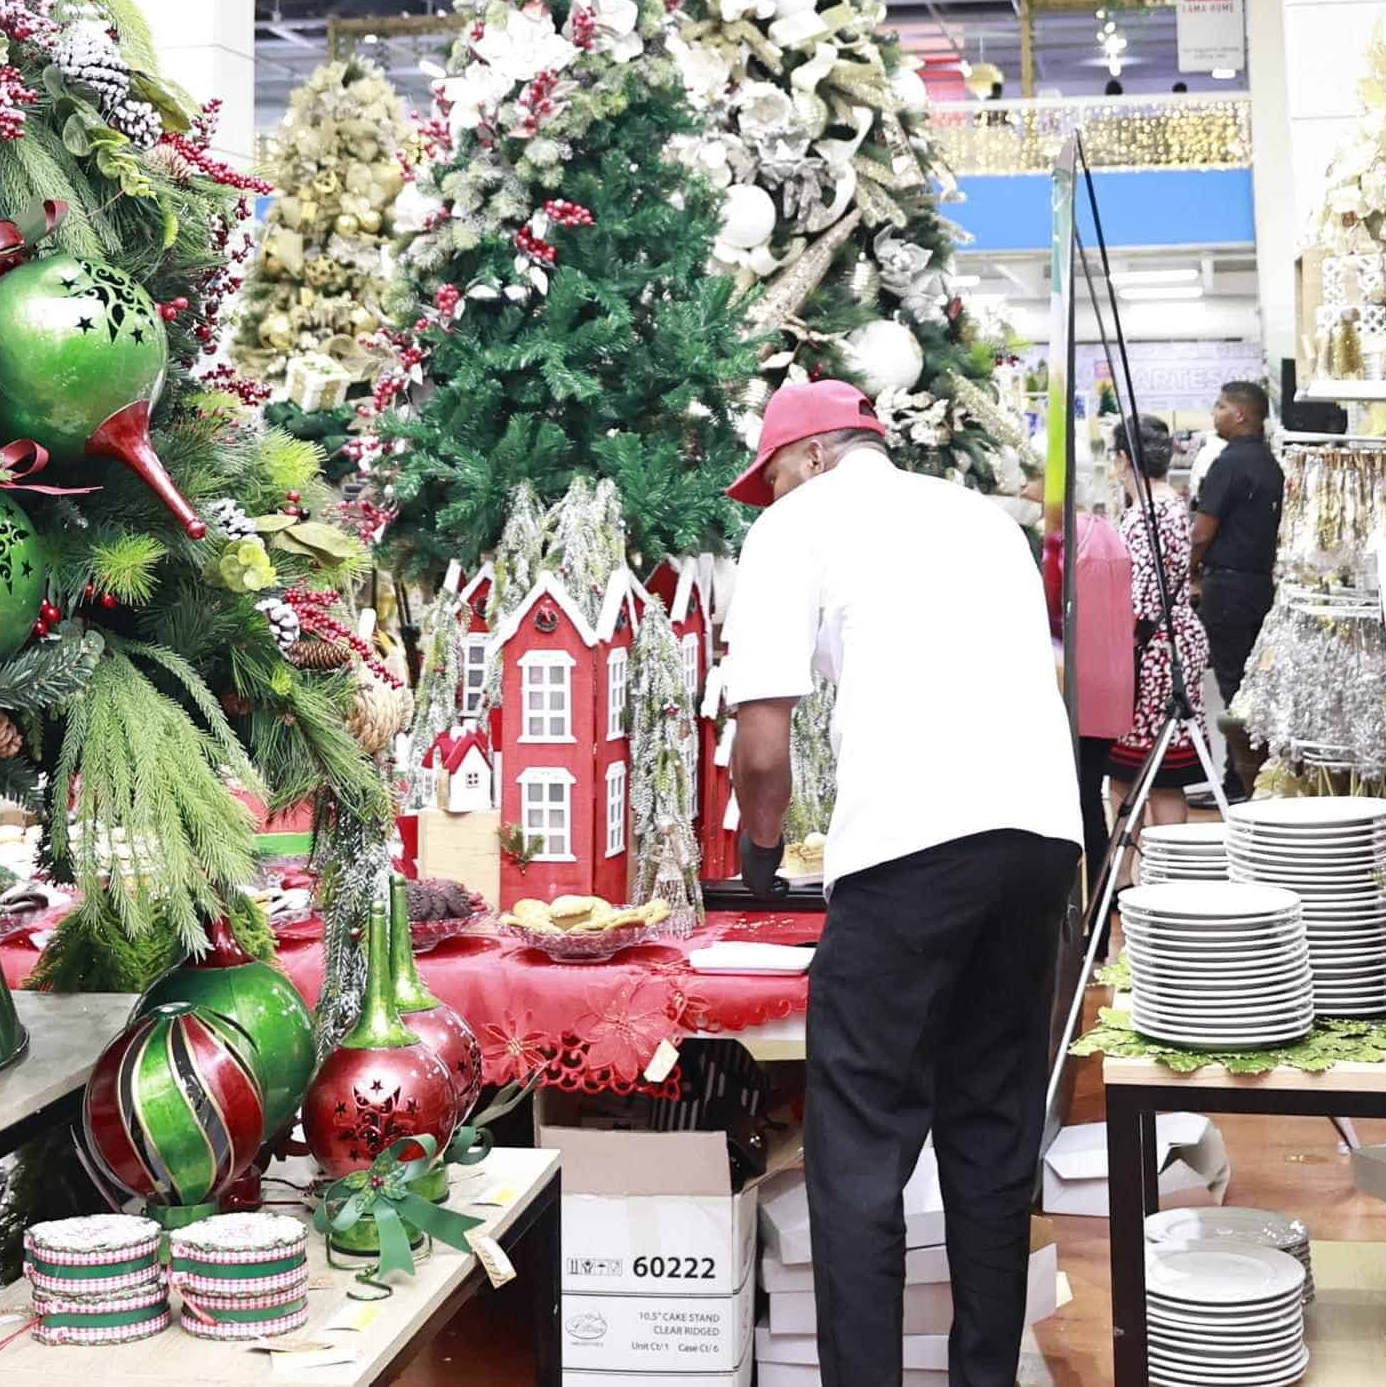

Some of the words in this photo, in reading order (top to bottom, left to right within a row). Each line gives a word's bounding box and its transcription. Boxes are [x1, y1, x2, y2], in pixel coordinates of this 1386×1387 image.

[632, 1256, 717, 1280] 60222
[663, 1312, 688, 1323] CAKE
[689, 1313, 721, 1324] STAND
[653, 1325, 683, 1336] CLEAR
[684, 1325, 721, 1337] RIDGED
[631, 1341, 649, 1351] Unit
[678, 1343, 698, 1353] Case
